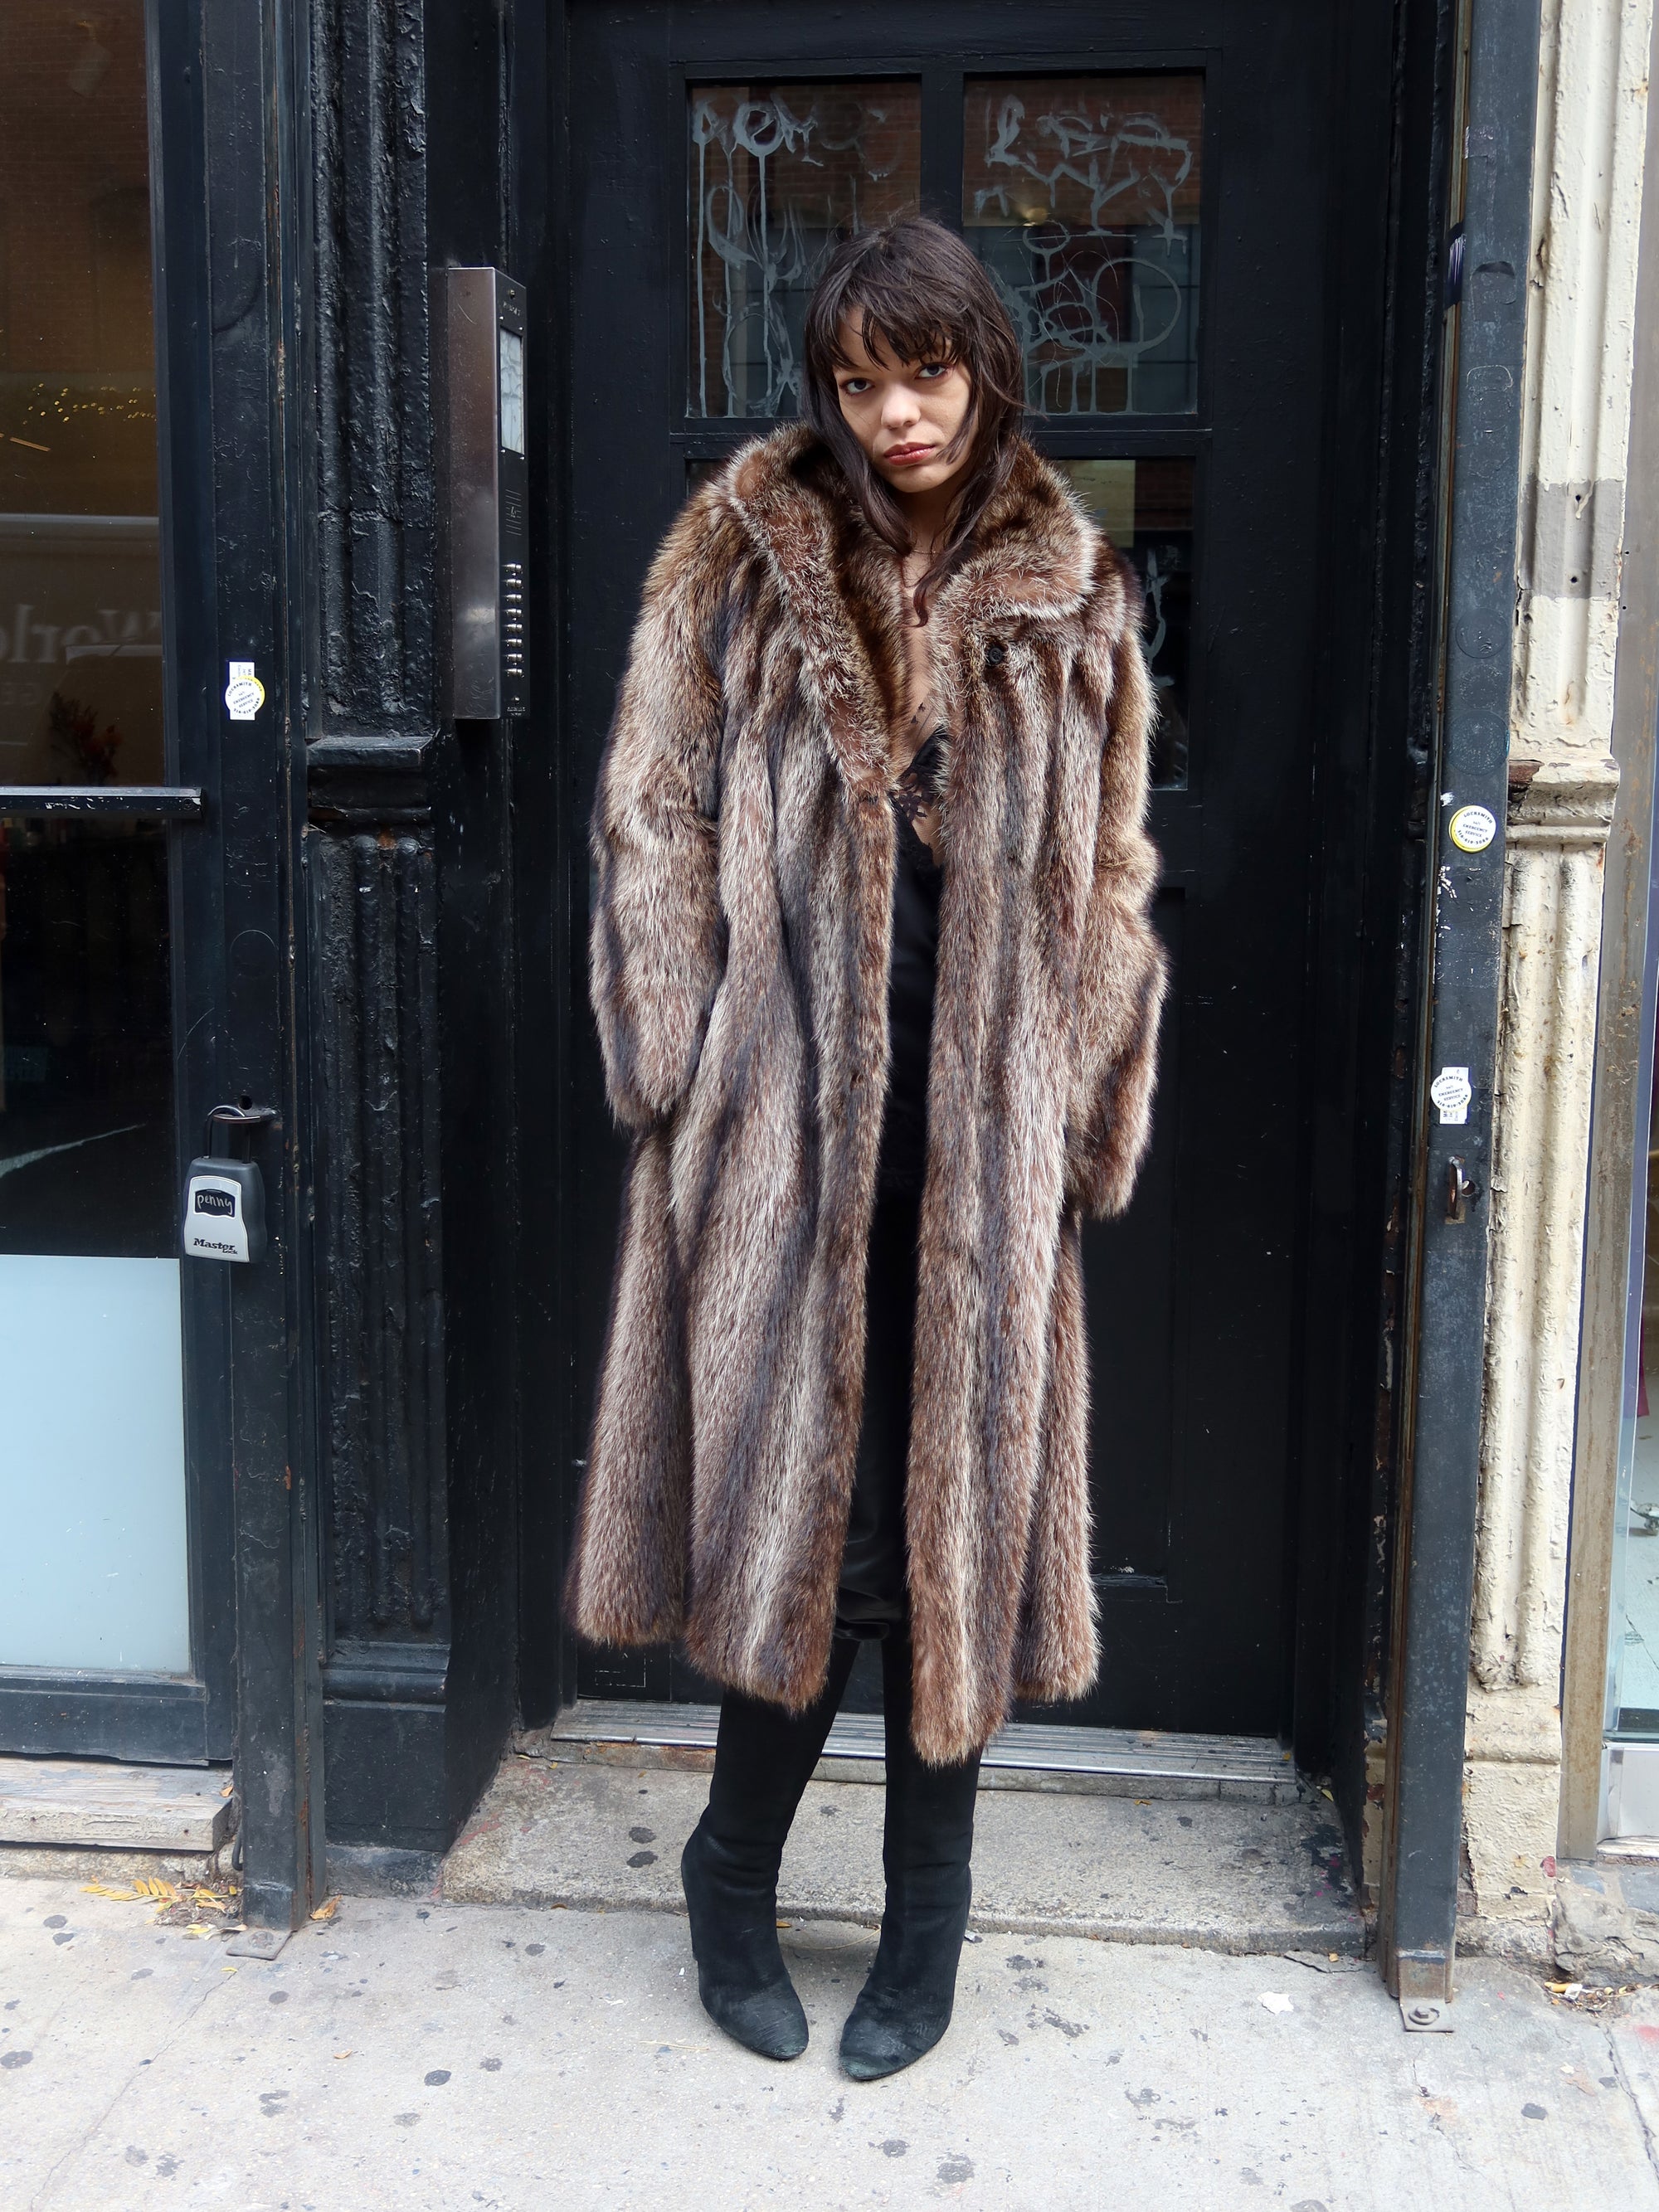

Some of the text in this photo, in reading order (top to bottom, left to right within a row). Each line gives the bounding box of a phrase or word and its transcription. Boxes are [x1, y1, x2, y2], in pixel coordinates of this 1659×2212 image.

[227, 682, 252, 697] LOCKSMITH
[233, 692, 255, 705] EMERGENCY
[1463, 811, 1493, 824] LOCKSMITH
[1462, 824, 1488, 833] EMERGENCY
[1433, 1076, 1463, 1088] LOCKSMITH
[1438, 1087, 1464, 1097] EMERGENCY
[197, 1194, 233, 1215] penny
[193, 1237, 236, 1251] Master
